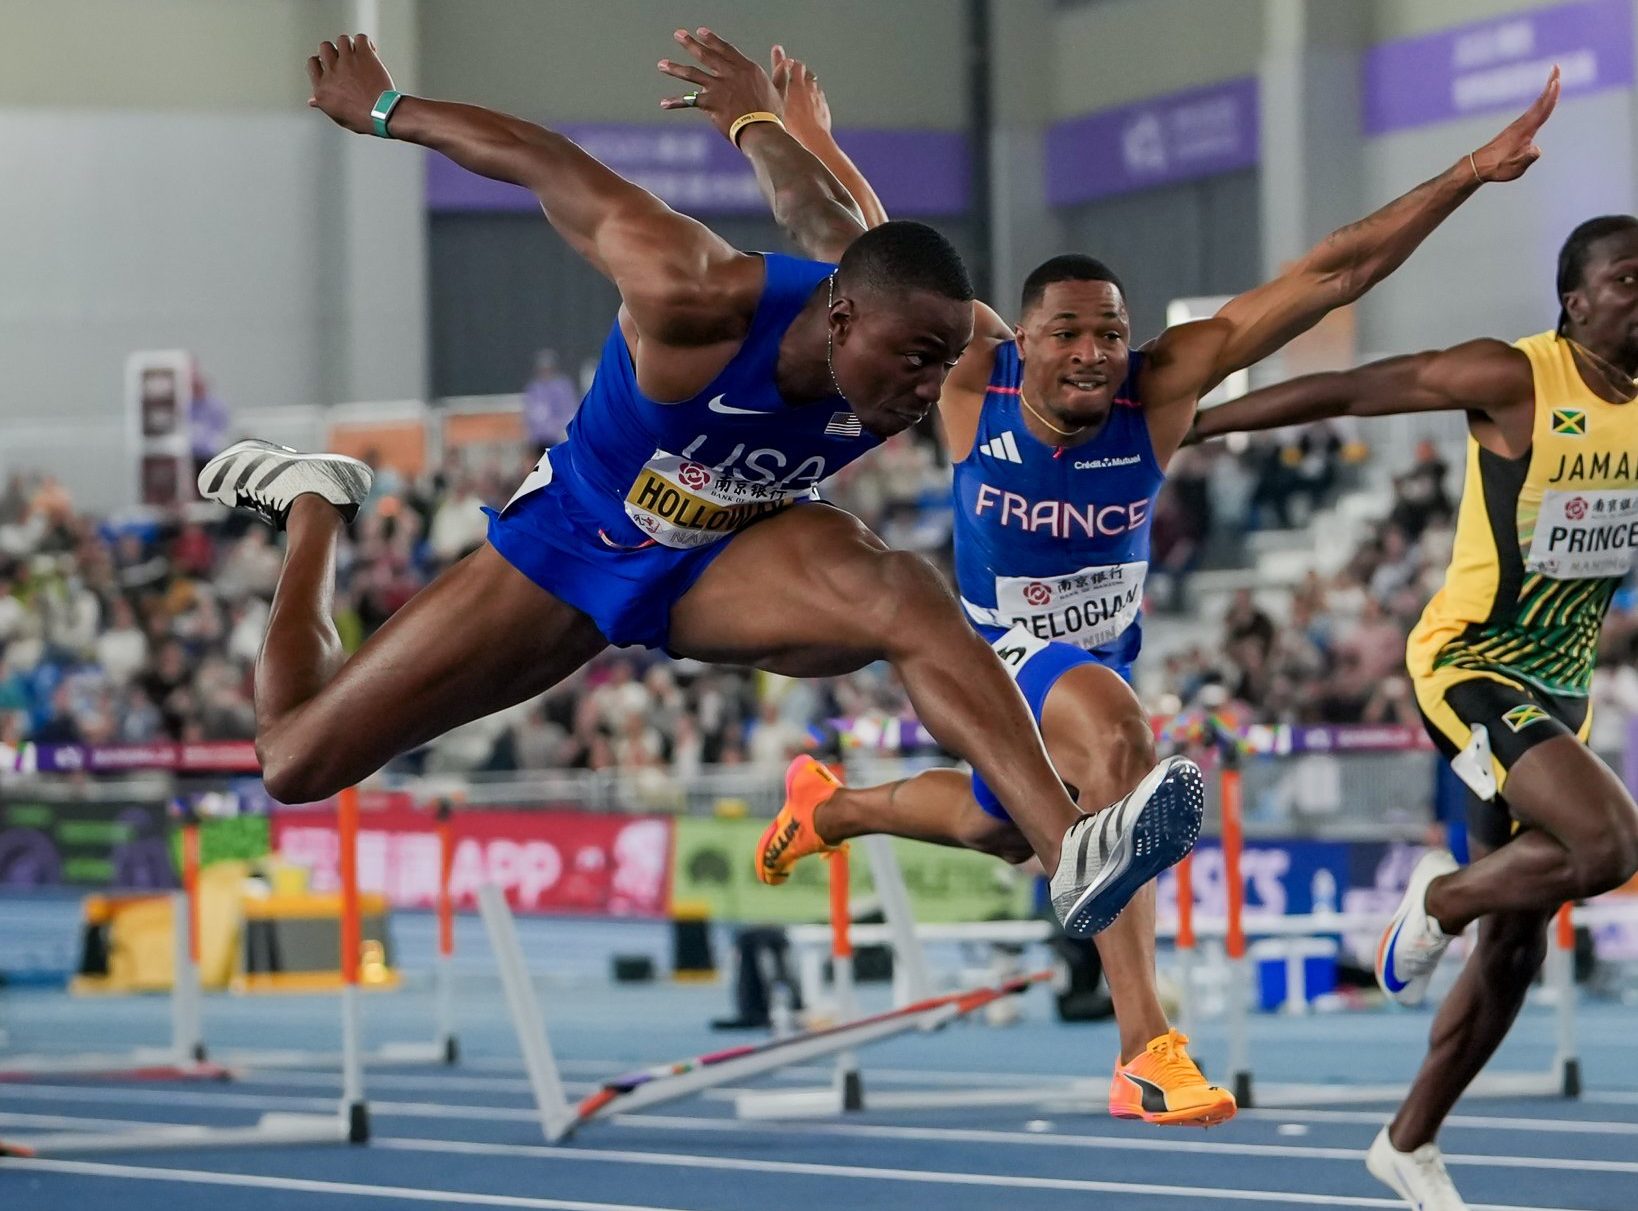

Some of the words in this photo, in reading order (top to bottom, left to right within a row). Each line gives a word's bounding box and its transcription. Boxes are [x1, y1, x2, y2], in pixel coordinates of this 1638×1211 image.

[682, 434, 825, 488] USA
[1074, 459, 1101, 470] Crédit
[1112, 454, 1141, 466] Mutuel
[714, 475, 788, 500] 南京银行
[975, 483, 1149, 538] FRANCE
[1548, 521, 1638, 553] PRINCE
[1058, 564, 1124, 593] 南京银行
